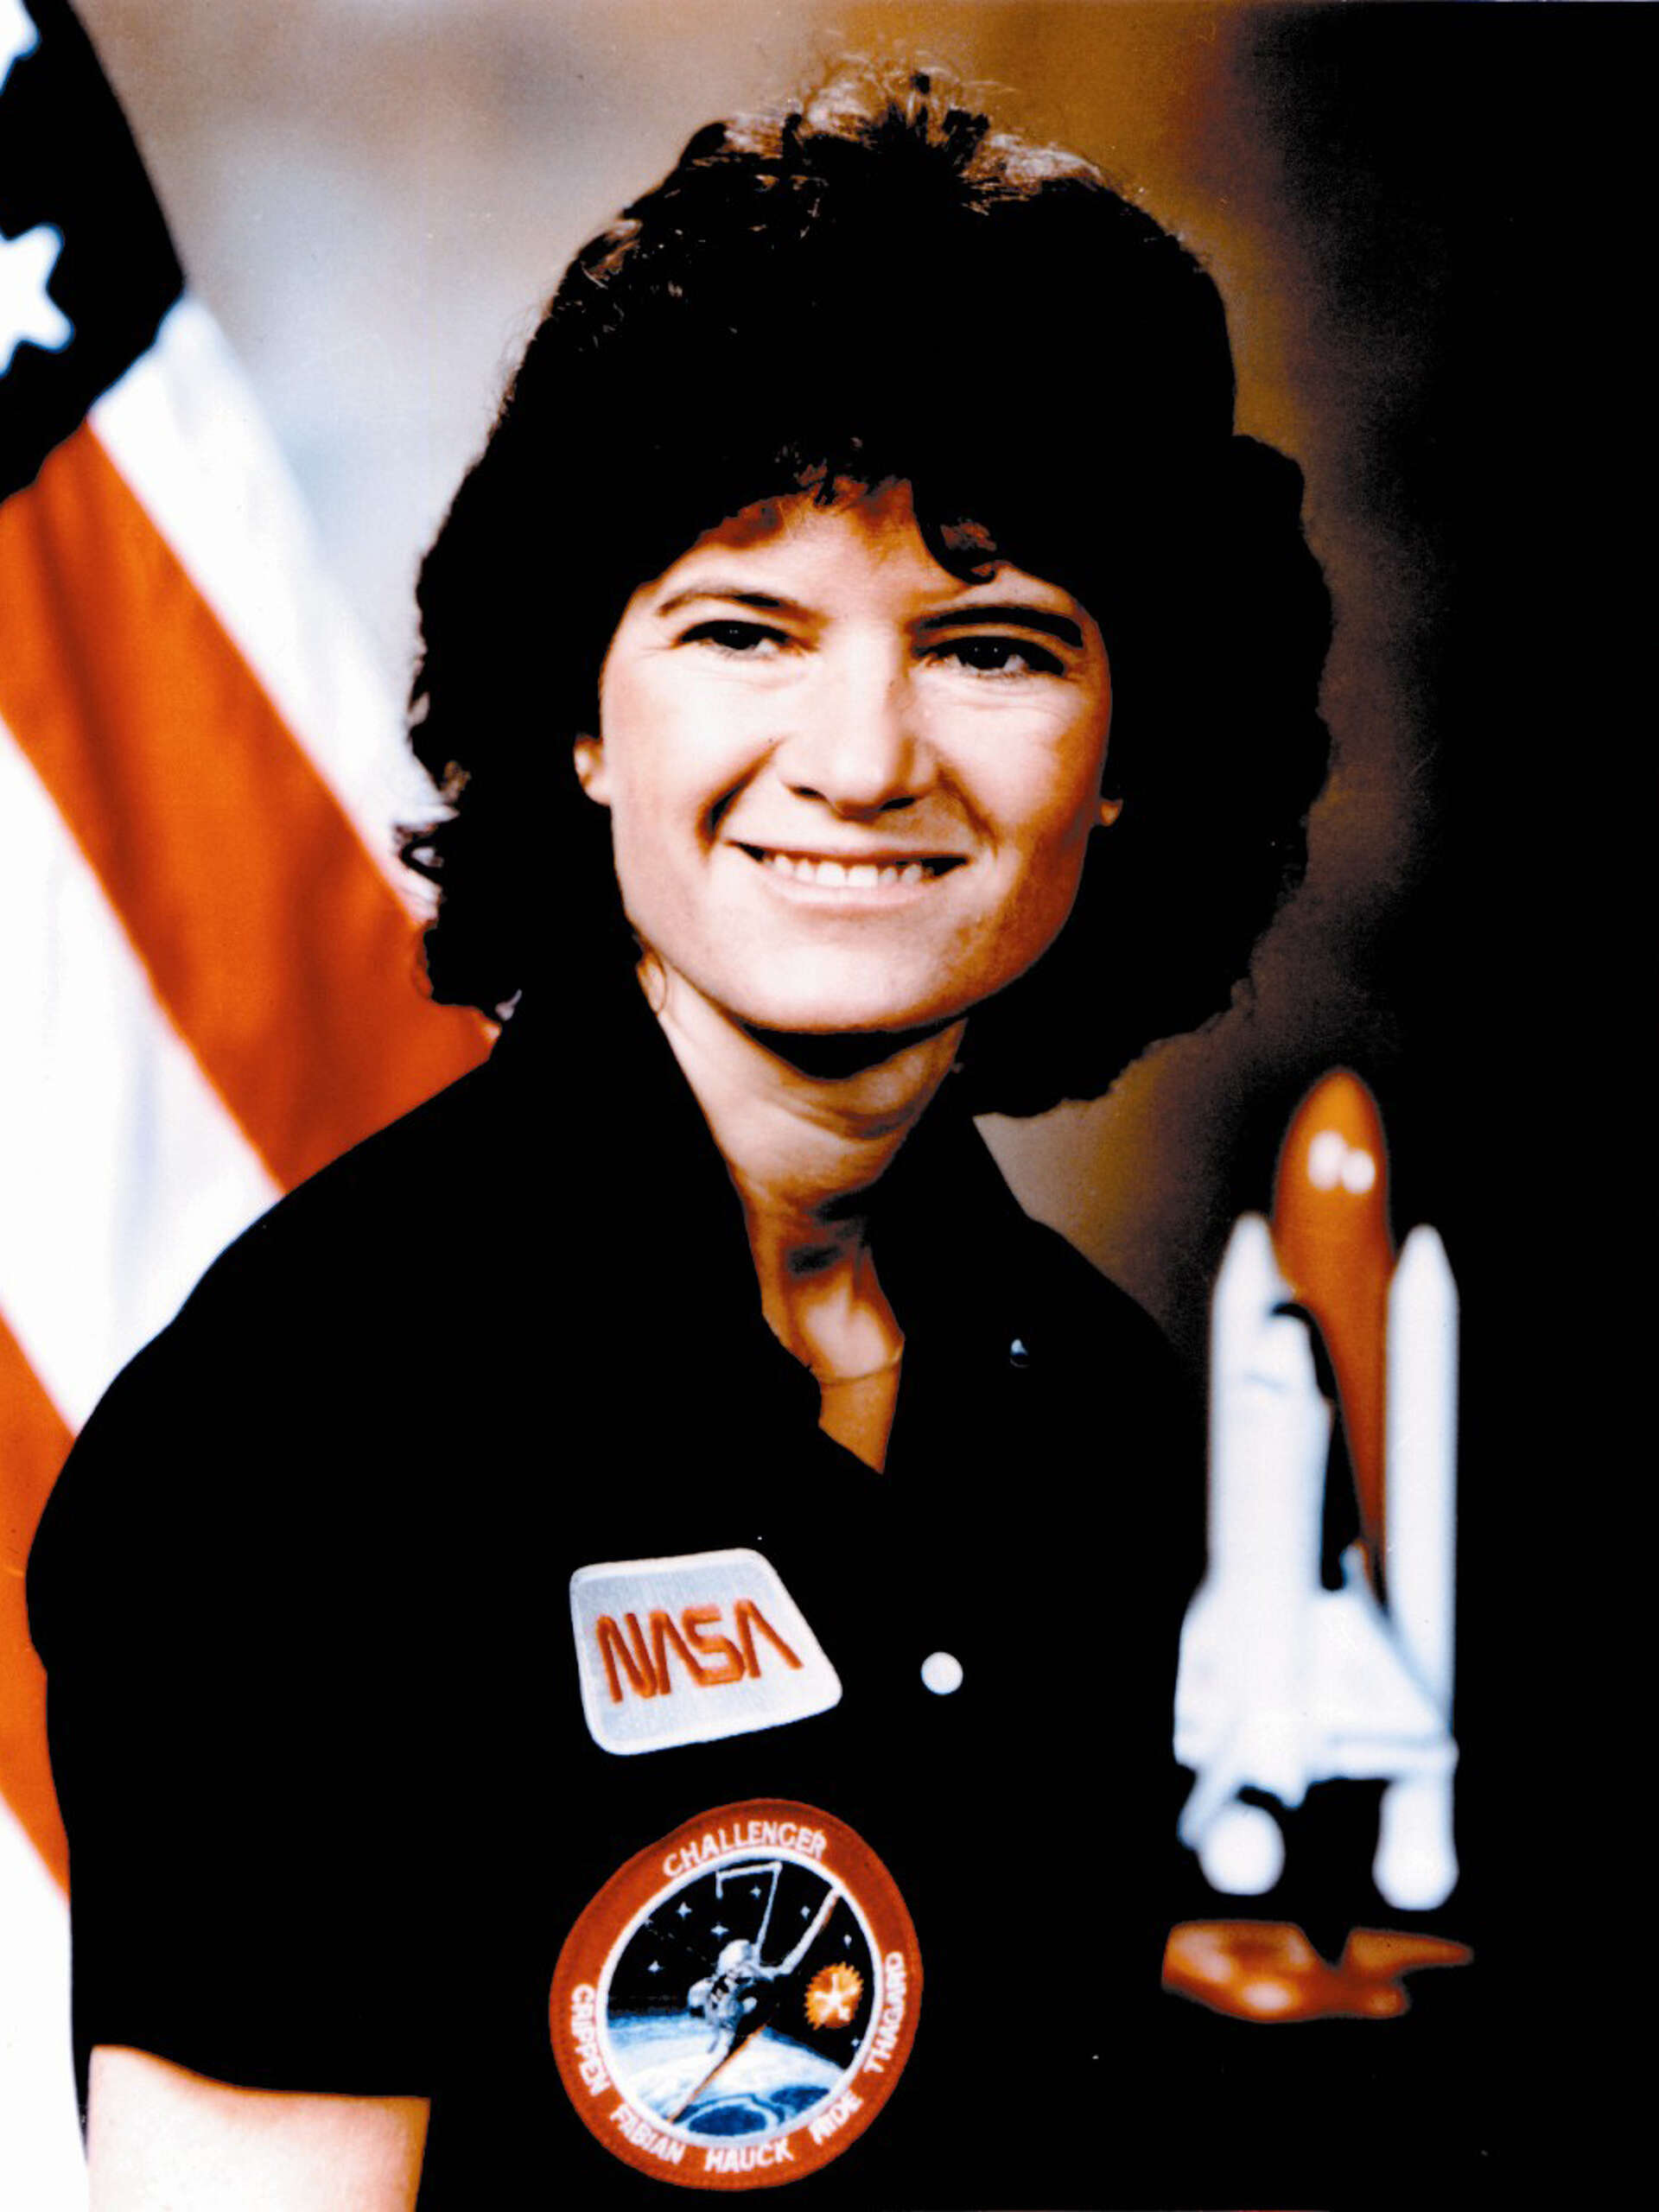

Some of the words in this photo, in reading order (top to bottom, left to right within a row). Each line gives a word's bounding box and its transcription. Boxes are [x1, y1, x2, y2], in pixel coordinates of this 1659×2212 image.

[595, 1599, 804, 1704] NASA
[663, 1821, 827, 1878] CHALLENGER
[571, 1983, 610, 2096] CRIPPEN
[609, 2102, 686, 2164] FABIAN
[703, 2139, 795, 2173] HAUCK
[862, 1951, 907, 2075] THAGARD
